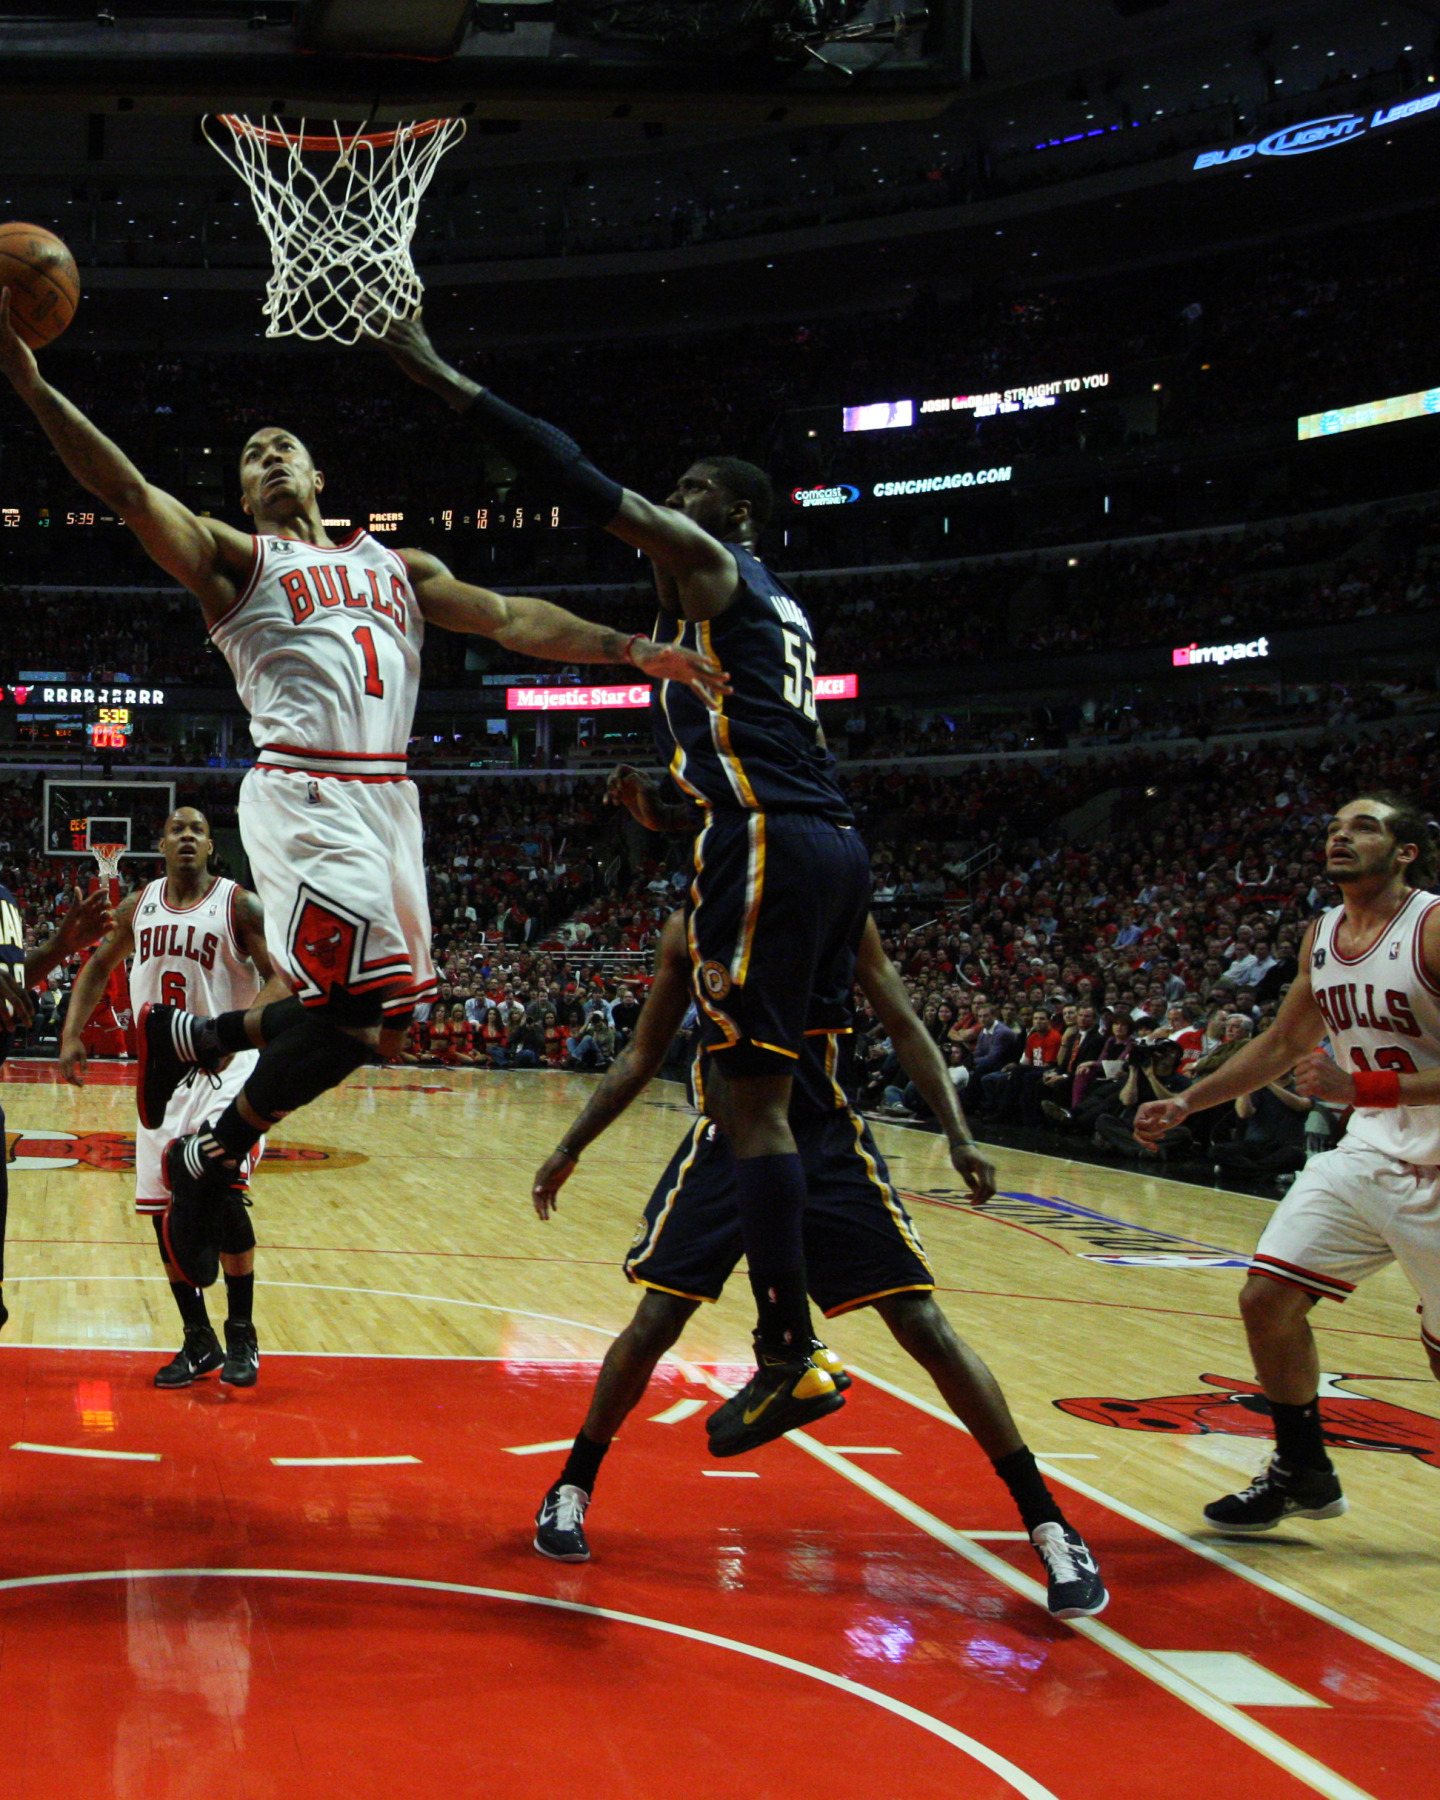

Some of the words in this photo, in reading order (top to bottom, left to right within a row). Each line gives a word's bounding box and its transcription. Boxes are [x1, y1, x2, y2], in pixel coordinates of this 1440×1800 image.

[1193, 143, 1256, 170] BUD
[1274, 116, 1364, 150] LIGHT
[920, 399, 950, 414] JOSH
[952, 391, 1002, 411] GROBAN:
[1004, 380, 1062, 402] STRAIGHT
[1064, 378, 1080, 393] TO
[1082, 373, 1109, 390] YOU
[794, 486, 842, 500] comcast
[872, 466, 1013, 497] CSNCHICAGO.COM
[3, 514, 21, 528] 52
[65, 512, 95, 526] 5:39
[369, 512, 404, 522] PACERS
[369, 523, 398, 532] BULLS
[441, 510, 453, 521] 10
[477, 509, 488, 519] 13
[512, 518, 523, 528] 13
[279, 565, 407, 637] BULLS
[351, 625, 384, 699] 1
[1188, 637, 1269, 665] impact
[781, 628, 816, 722] 55
[516, 689, 588, 710] Majestic
[591, 688, 626, 705] Star
[99, 708, 128, 724] 5:39
[92, 724, 126, 747] 06
[140, 925, 219, 971] BULLS
[161, 971, 187, 1011] 6
[1315, 983, 1422, 1038] BULLS
